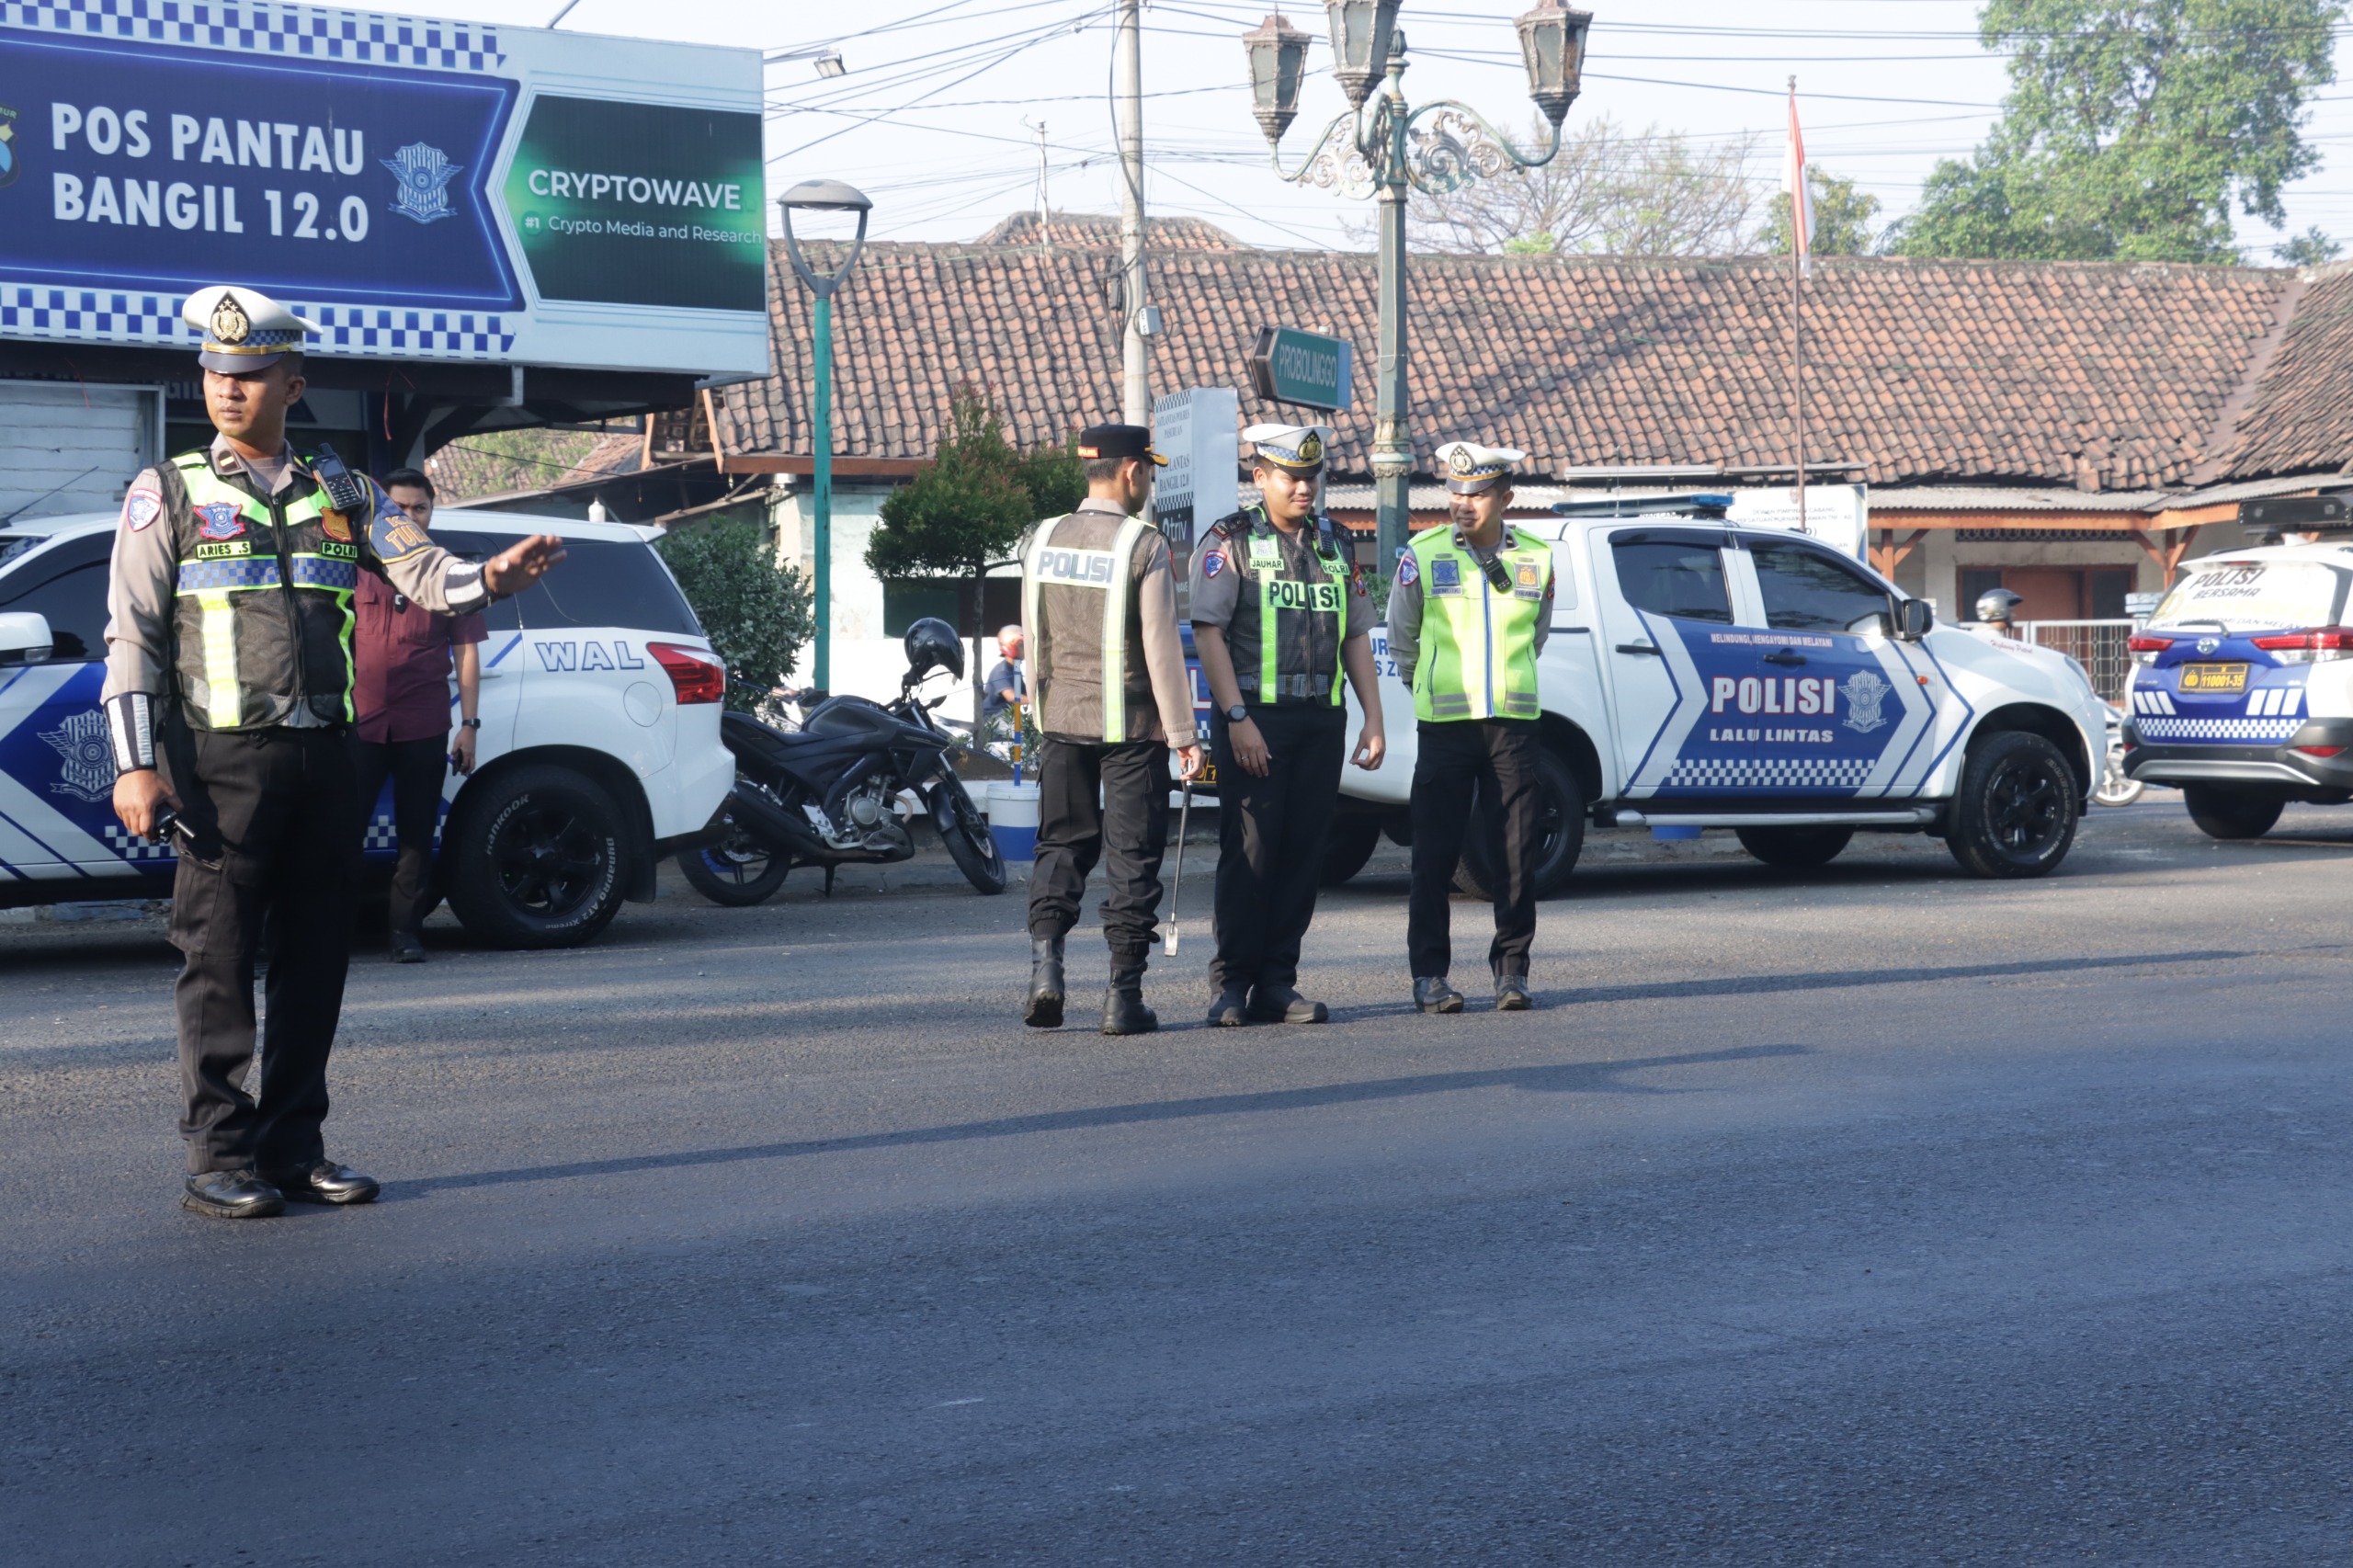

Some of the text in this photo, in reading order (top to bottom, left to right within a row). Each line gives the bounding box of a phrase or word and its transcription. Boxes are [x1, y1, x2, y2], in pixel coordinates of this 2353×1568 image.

[51, 102, 364, 176] POS PANTAU
[529, 169, 742, 210] CRYPTOWAVE
[52, 172, 369, 242] BANGIL 12.0
[525, 216, 762, 244] #1 Crypto Media and Research
[1279, 343, 1336, 388] PROBOLINGGO
[1169, 454, 1189, 472] LANTAS
[1159, 475, 1179, 493] BANGIL
[199, 543, 232, 557] ARIES
[324, 543, 358, 558] POLRI
[1037, 551, 1115, 584] POLISI
[1252, 560, 1282, 569] JAUHAR
[1323, 563, 1348, 574] POLRI
[2189, 568, 2268, 589] POLISI
[2192, 587, 2261, 599] BERSAMA
[1790, 635, 1802, 646] DAN
[533, 641, 645, 672] WAL
[1711, 676, 1836, 714] POLISI
[1710, 728, 1834, 743] LALU LINTAS
